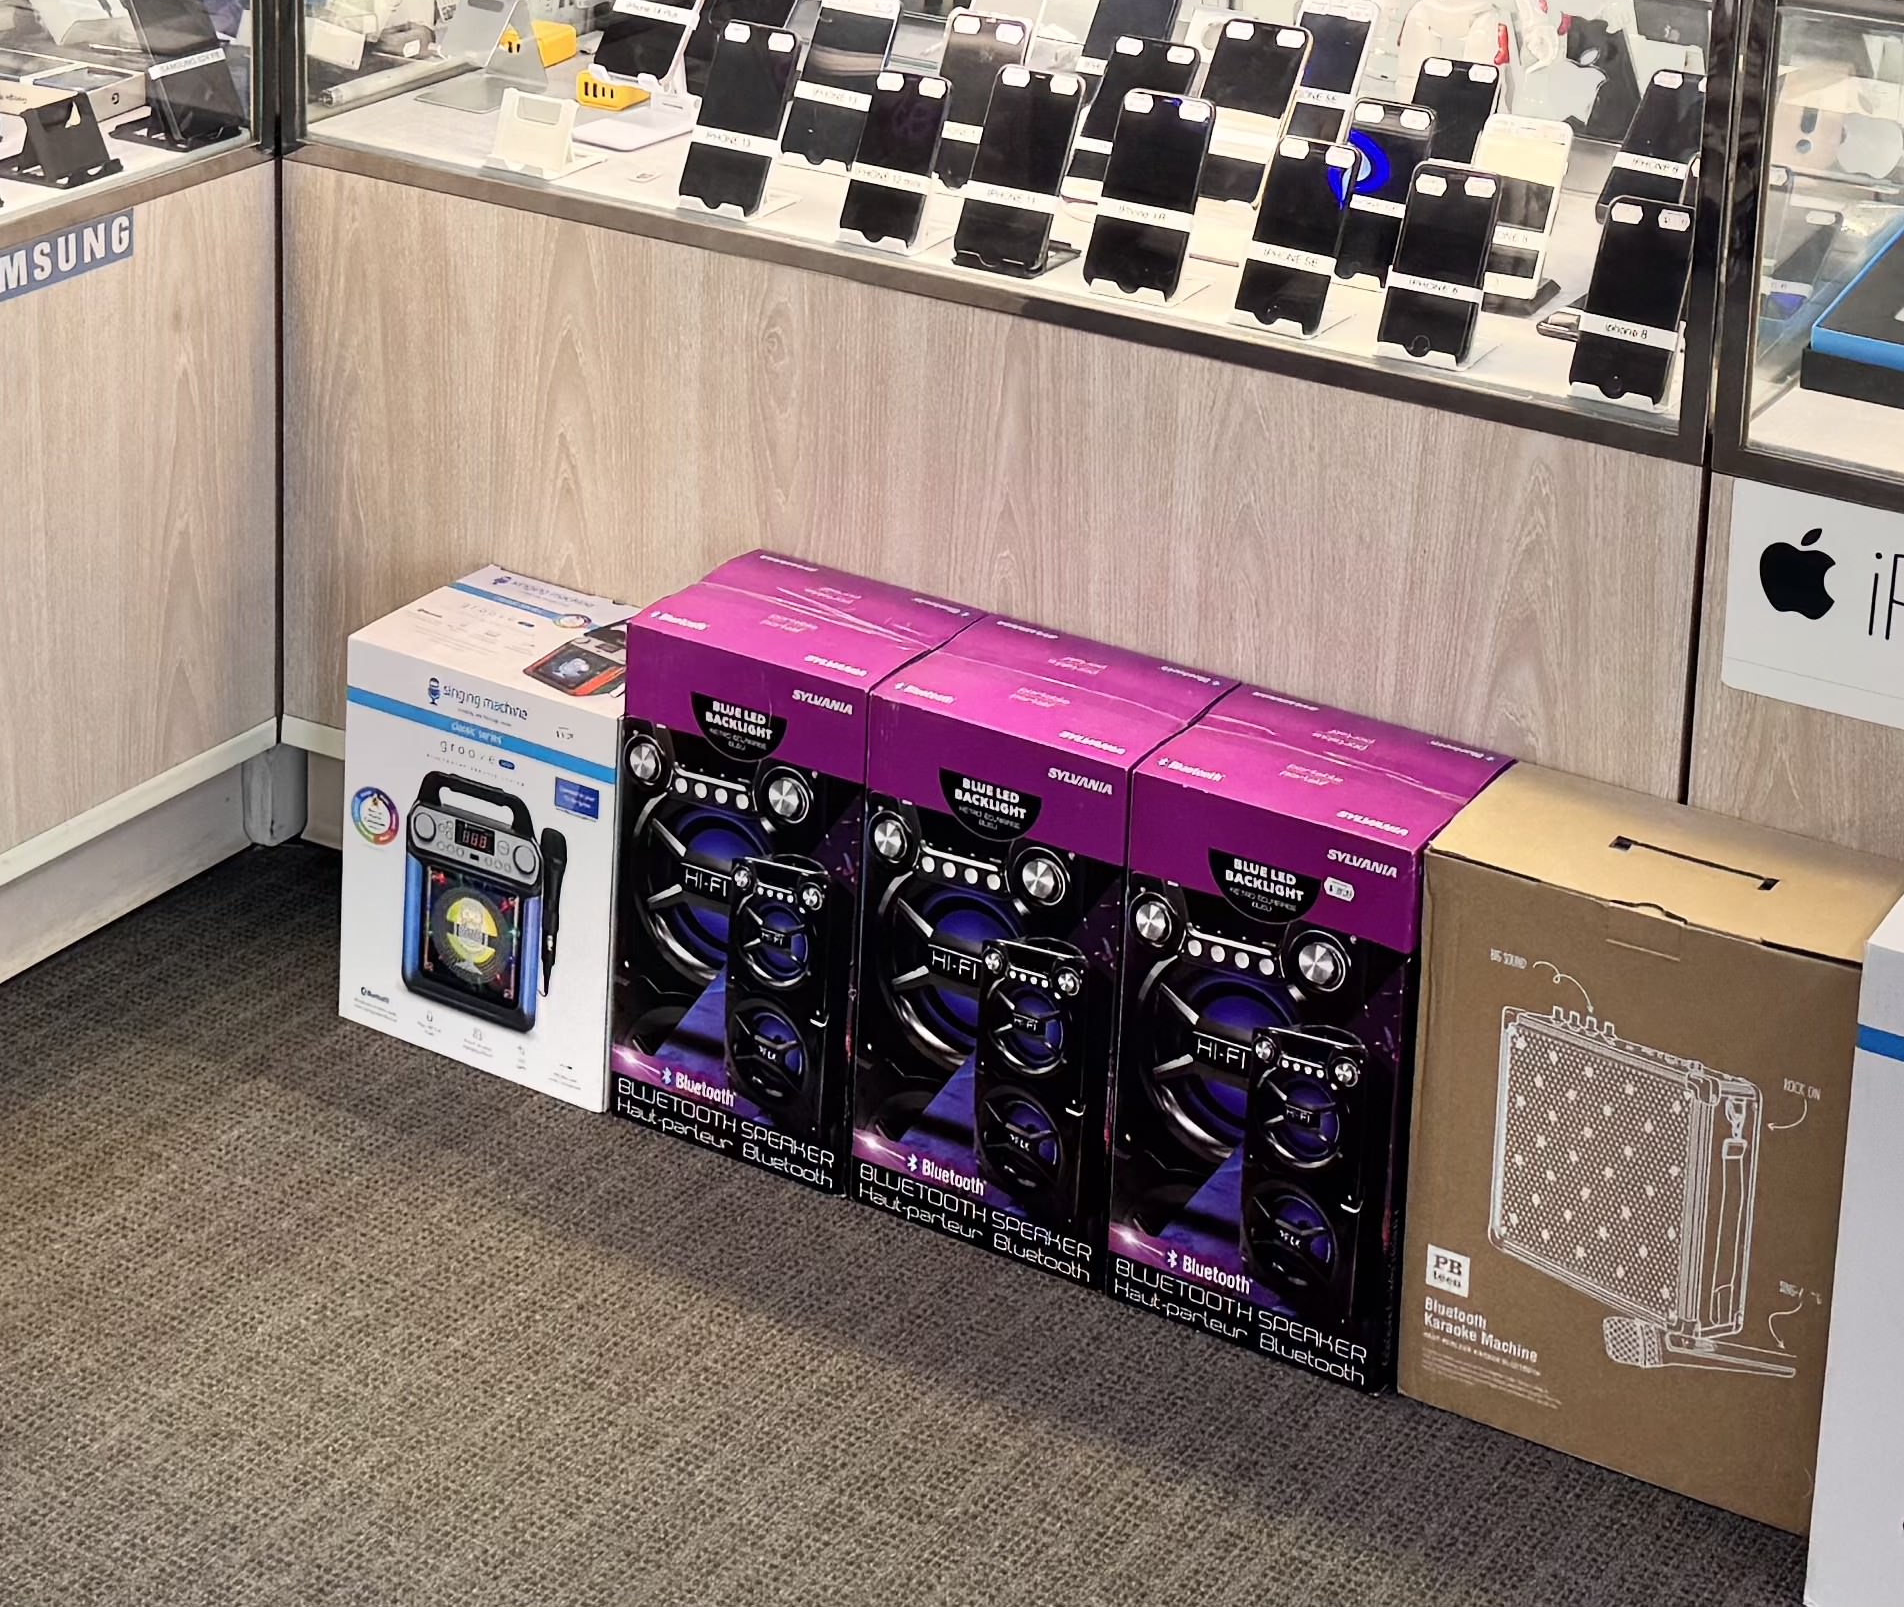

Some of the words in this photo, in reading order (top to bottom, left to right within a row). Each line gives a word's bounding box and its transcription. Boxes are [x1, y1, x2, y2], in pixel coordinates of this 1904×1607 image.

[442, 683, 484, 713] singing
[485, 694, 529, 723] machine
[712, 699, 739, 718] BLUE
[741, 706, 767, 726] LED
[792, 689, 853, 716] SYLVANIA
[704, 710, 775, 743] BACKLIGHT
[961, 776, 990, 798] BLUE
[993, 784, 1020, 805] LED
[1047, 767, 1113, 796] SYLVANIA
[953, 788, 1027, 822] BACKLIGHT
[1232, 857, 1269, 875] BLUE
[1269, 865, 1296, 885] LED
[1326, 848, 1398, 879] SYLVANIA
[682, 868, 728, 900] HI-FI
[1224, 868, 1304, 902] BACKLIGHT
[930, 949, 978, 982] HI-FI
[1196, 1035, 1247, 1070] HI-FI
[674, 1073, 736, 1108] Bluetooth
[617, 1077, 737, 1135] BLUETOOTH
[740, 1121, 836, 1170] SPEAKER
[616, 1096, 733, 1152] Haut-parleur
[742, 1143, 835, 1191] Bluetooth
[922, 1158, 986, 1195] Bluetooth
[859, 1162, 989, 1222] BLUETOOTH
[991, 1208, 1093, 1263] SPEAKER
[858, 1180, 984, 1242] Haut-parleur
[993, 1230, 1091, 1285] Bluetooth
[1182, 1251, 1252, 1294] Bluetooth
[1432, 1252, 1463, 1274] PB
[1115, 1257, 1252, 1324] BLUETOOTH
[1256, 1309, 1368, 1366] SPEAKER
[1424, 1295, 1488, 1332] Bluetooth
[1114, 1277, 1248, 1343] Haut-parleur
[1257, 1330, 1366, 1388] Bluetooth
[1423, 1311, 1478, 1345] Karaoke
[1480, 1330, 1538, 1364] Machine
